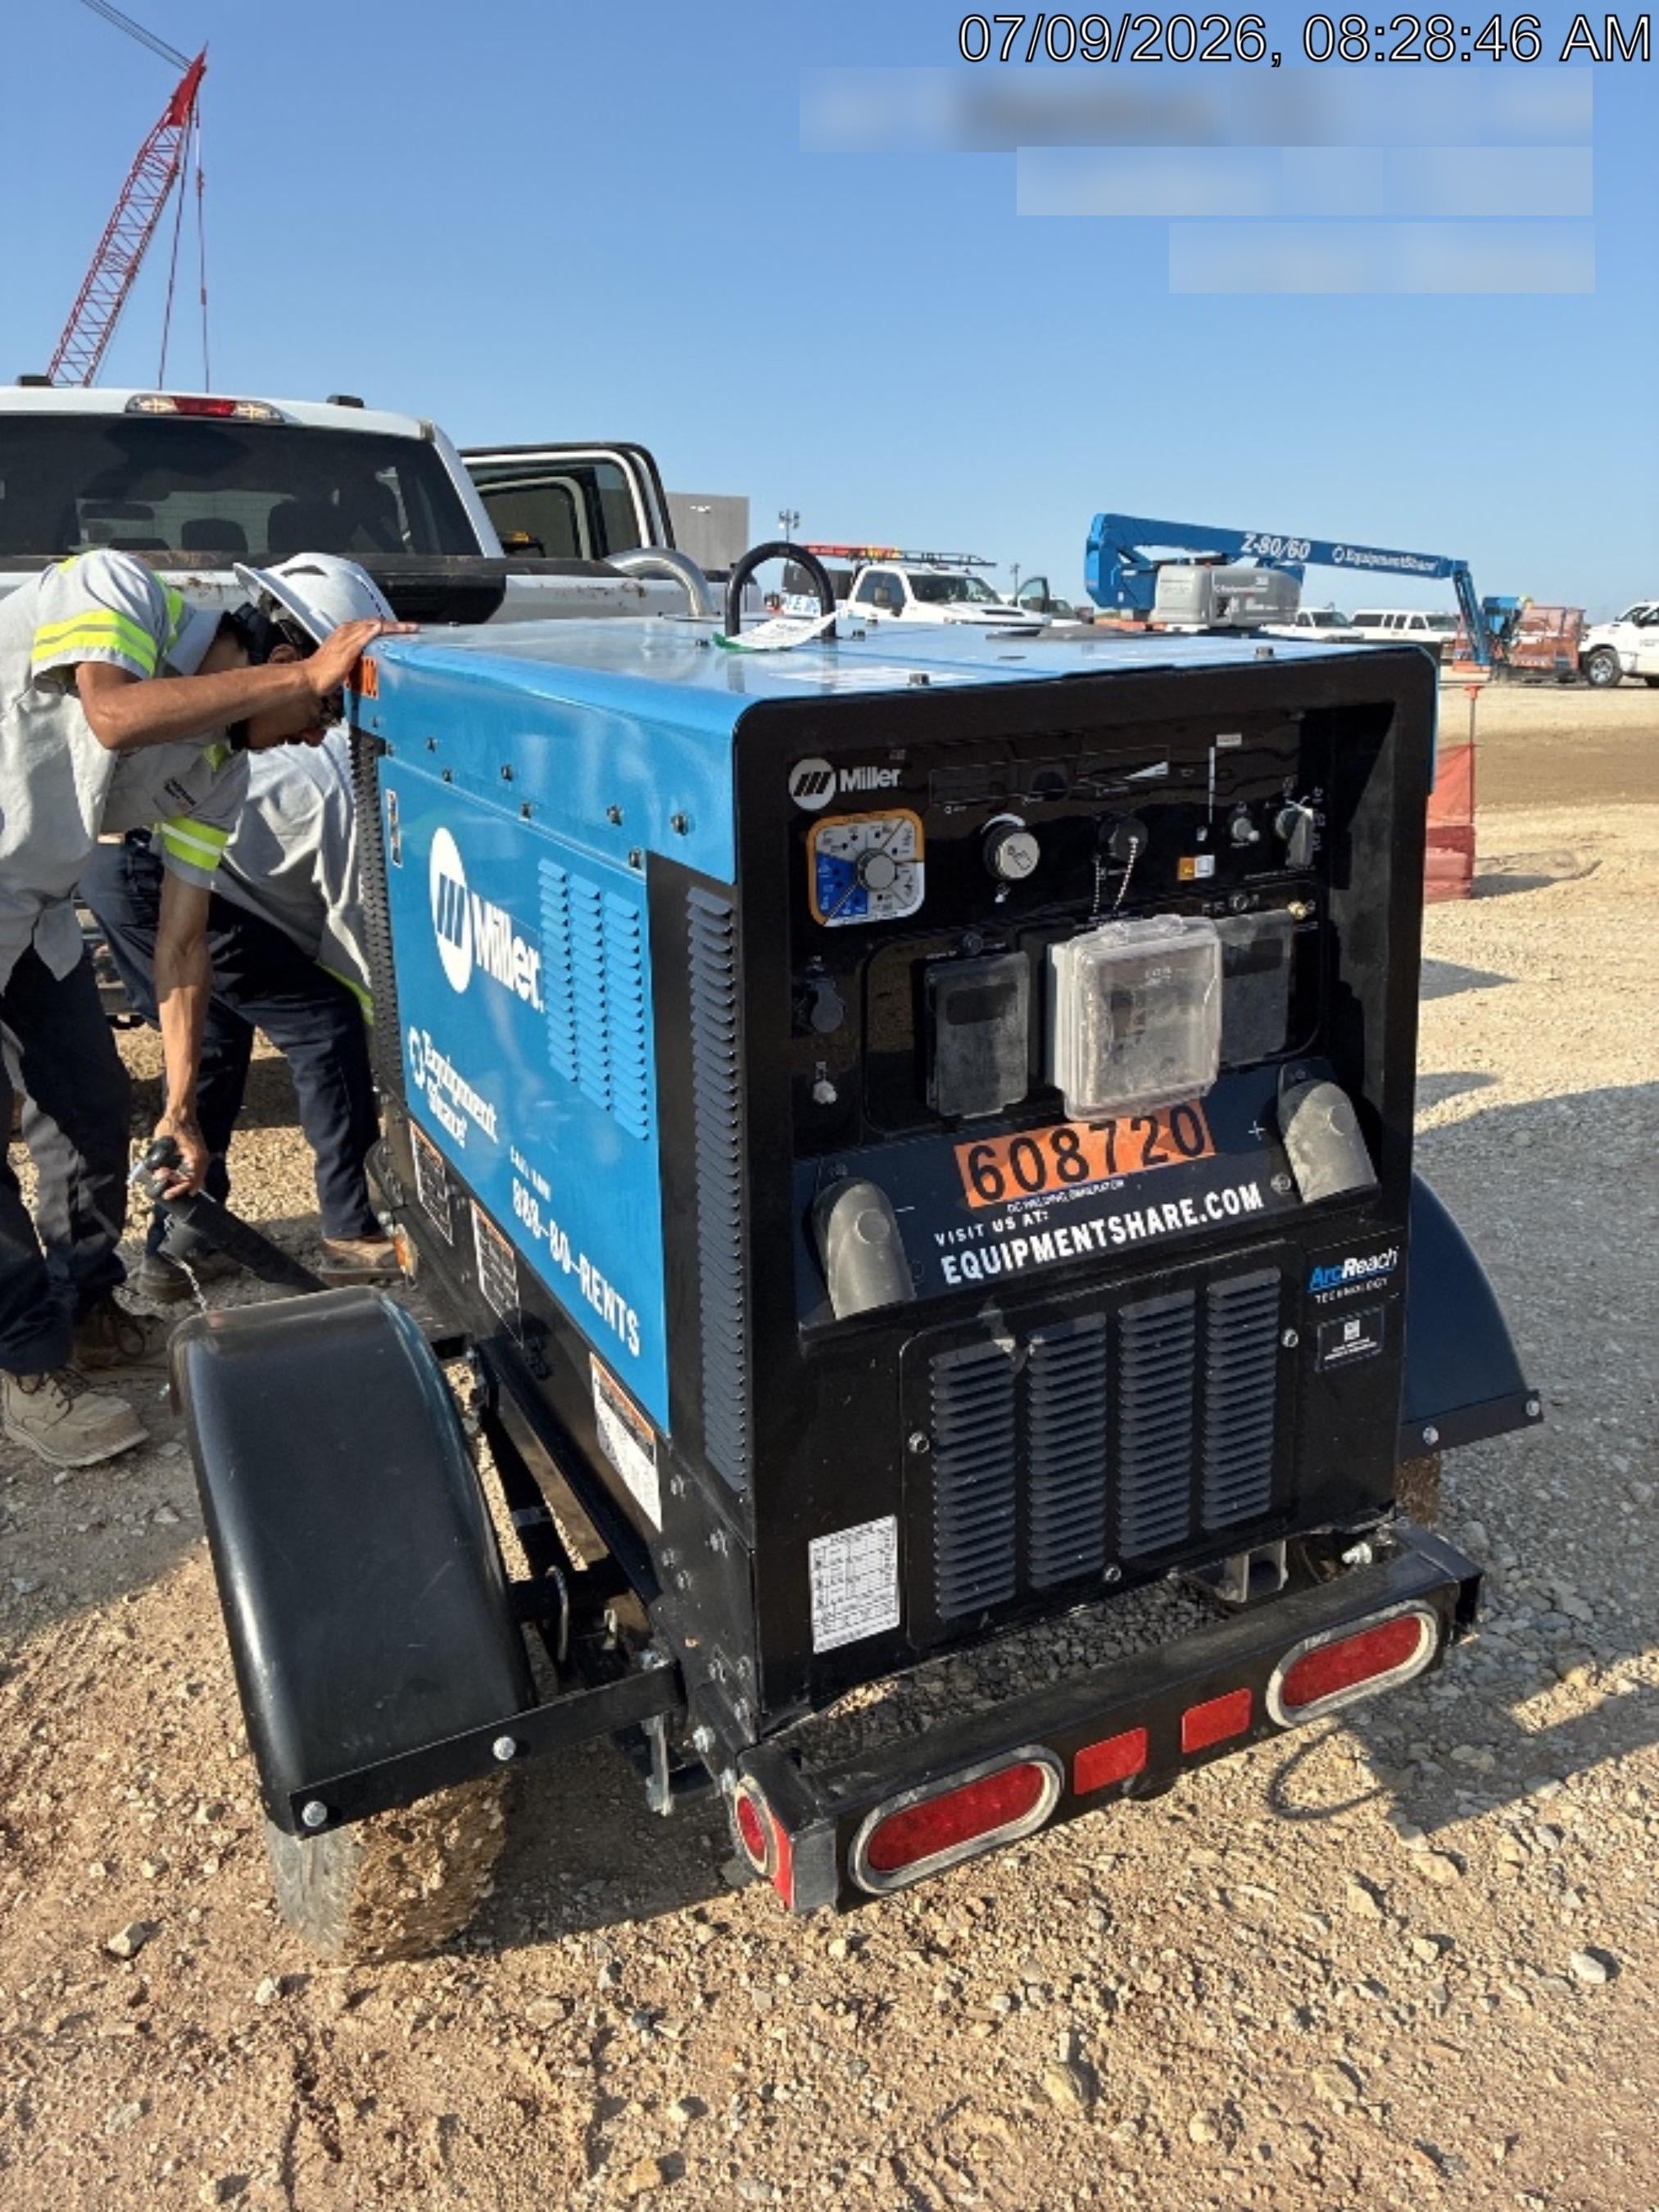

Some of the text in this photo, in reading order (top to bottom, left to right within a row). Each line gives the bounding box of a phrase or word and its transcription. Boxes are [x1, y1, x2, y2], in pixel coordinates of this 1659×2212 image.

[1240, 533, 1311, 560] Z-80/60
[840, 766, 902, 793] Miller
[471, 890, 546, 1013] Miller
[421, 1029, 500, 1145] Equipment
[967, 1104, 1207, 1202] 608720
[933, 1210, 1049, 1247] VISIT US AT:
[940, 1181, 1264, 1286] EQUIPMENTSHARE.COM
[1310, 1246, 1398, 1286] ArcReach
